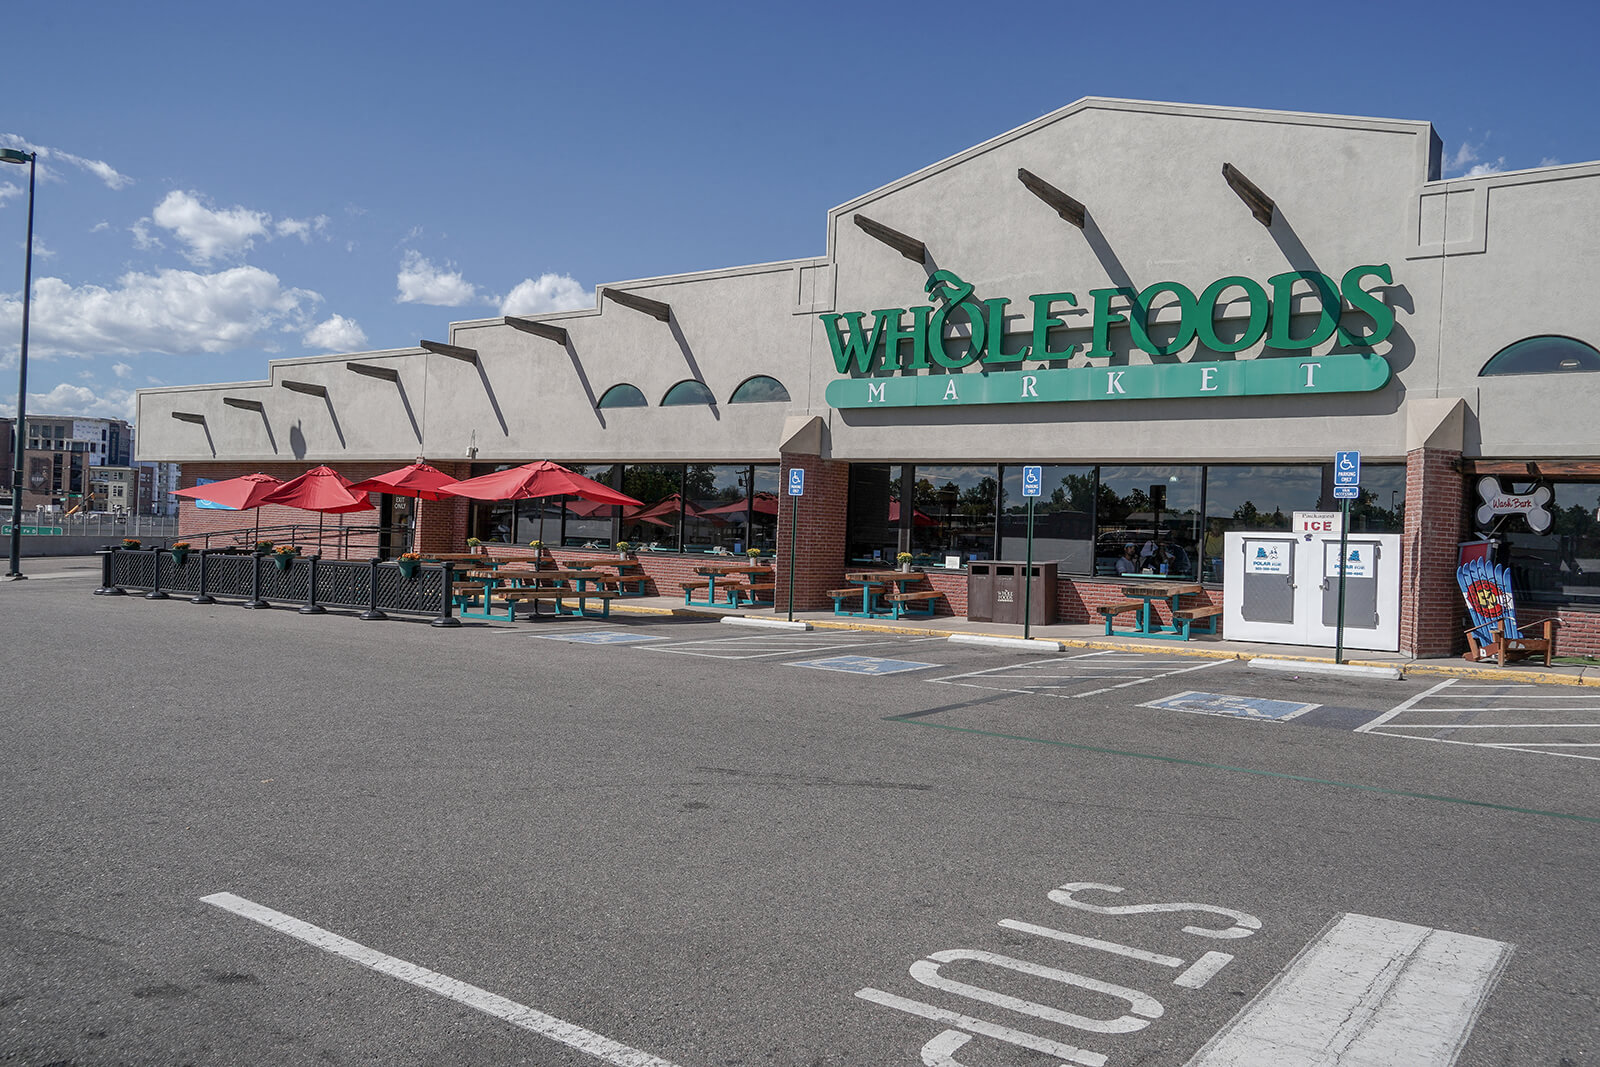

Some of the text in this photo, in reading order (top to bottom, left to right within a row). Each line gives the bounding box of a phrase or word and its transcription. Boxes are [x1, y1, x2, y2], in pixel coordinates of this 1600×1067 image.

[819, 263, 1395, 374] WHOLE FOODS
[868, 363, 1322, 403] MARKET
[1492, 498, 1532, 508] Wash Bark
[1304, 521, 1332, 531] ICE
